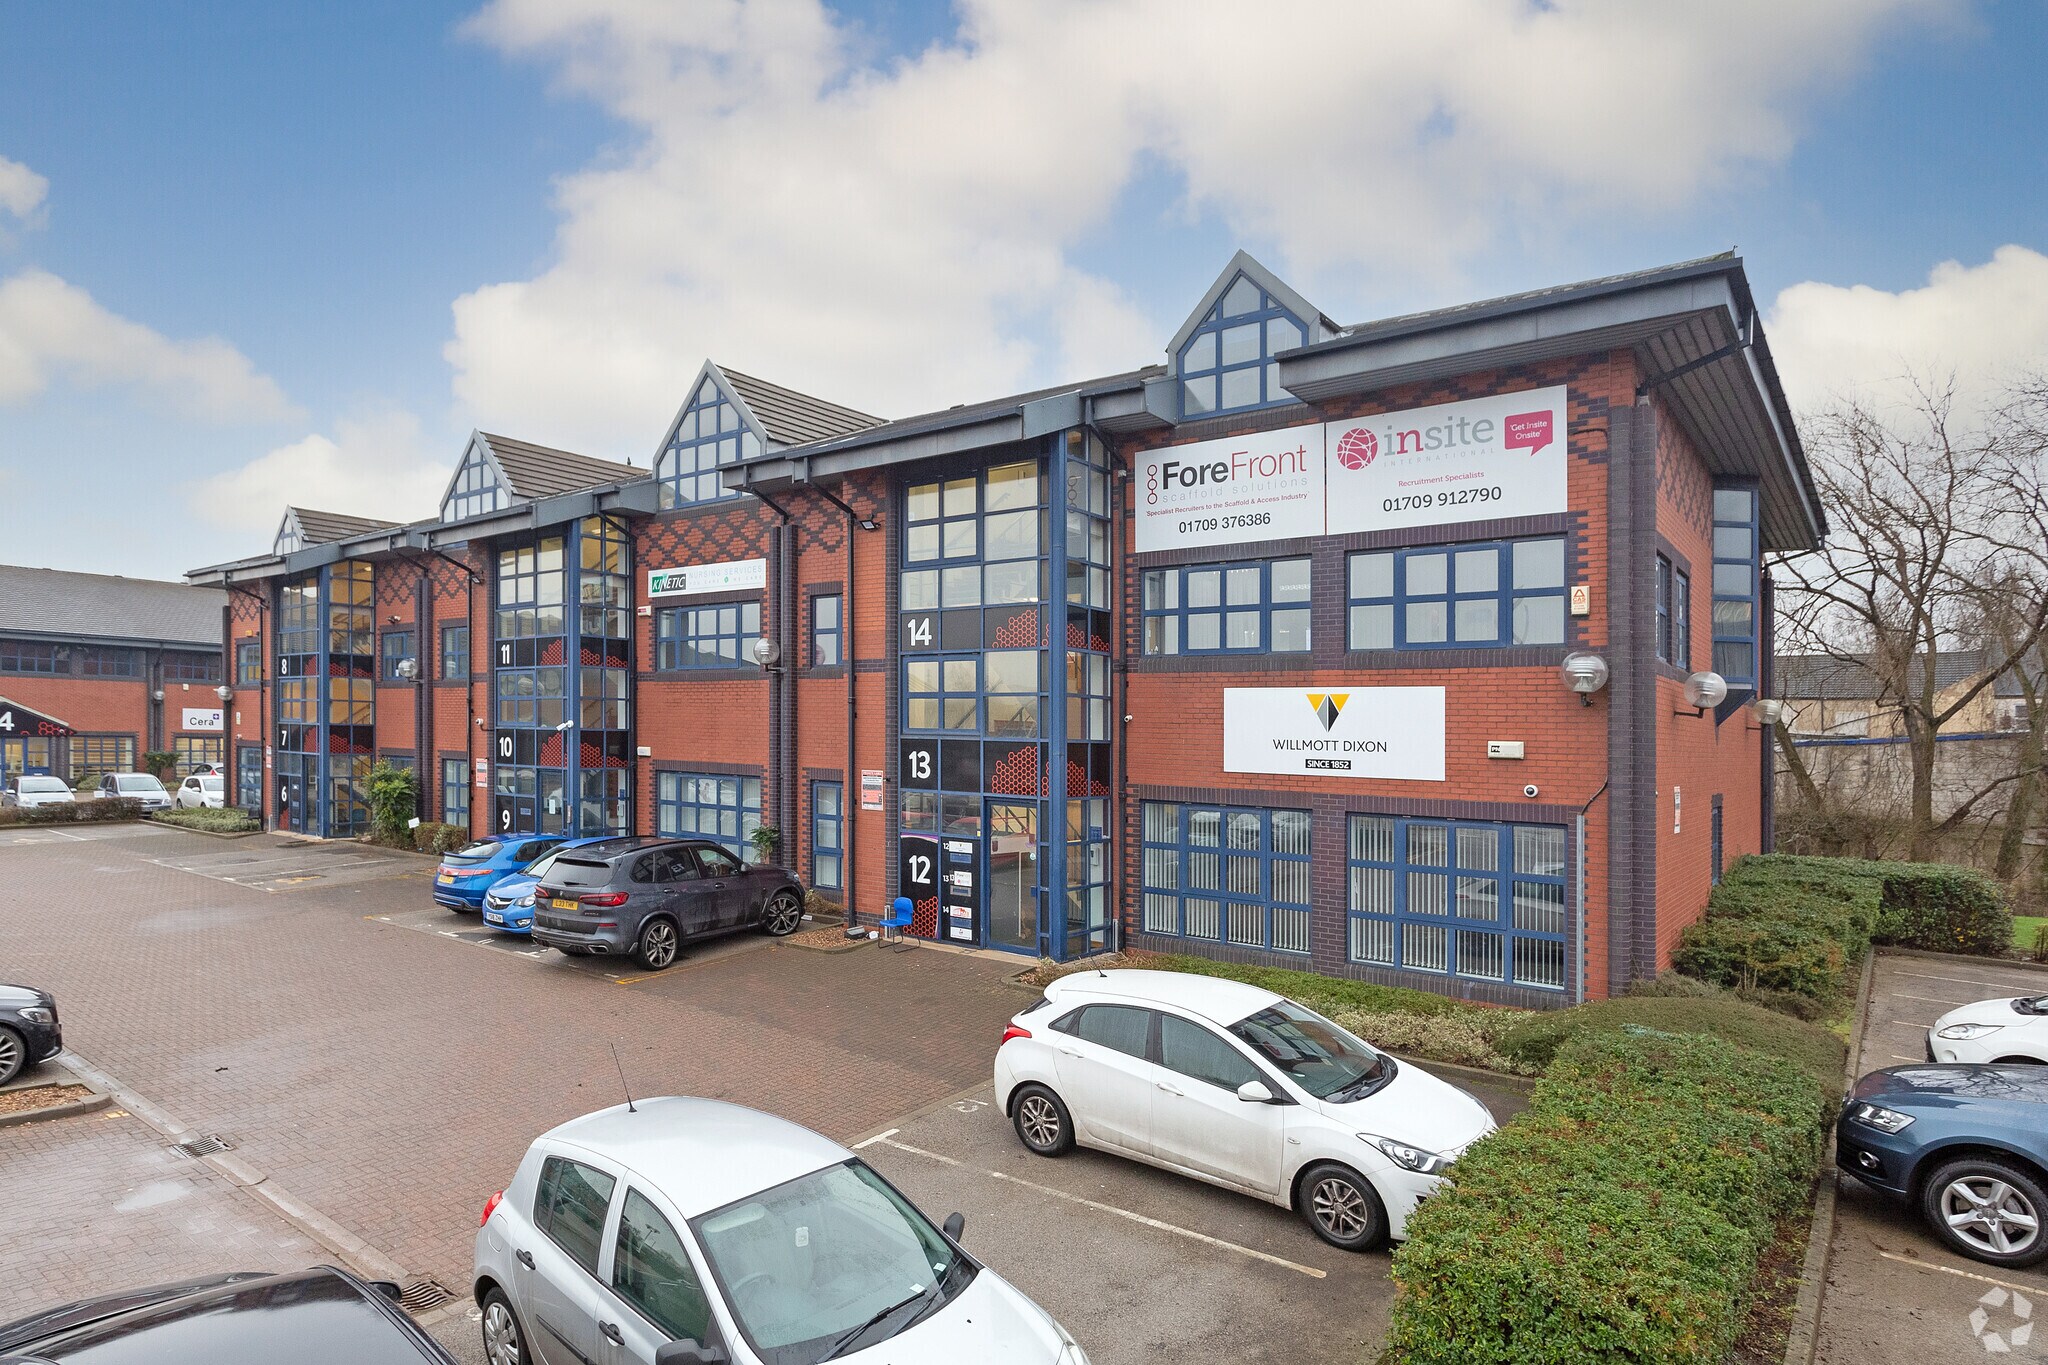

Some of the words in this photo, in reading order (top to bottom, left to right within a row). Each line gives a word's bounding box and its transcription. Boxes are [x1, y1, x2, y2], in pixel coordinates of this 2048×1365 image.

[1526, 420, 1548, 430] Insite
[1384, 415, 1495, 457] insite
[1162, 444, 1307, 490] ForeFront
[1384, 447, 1495, 468] INTERNATIONAL
[1398, 475, 1443, 487] Recruitment
[1444, 470, 1485, 482] Specialists
[1162, 486, 1223, 503] scaffold
[1232, 477, 1308, 495] solutions
[1383, 494, 1433, 512] 01709
[1438, 486, 1502, 506] 912790
[1174, 504, 1205, 514] Recruiters
[1224, 499, 1250, 508] Scaffold
[1256, 496, 1280, 504] Access
[1178, 518, 1218, 534] 01709
[1221, 512, 1271, 529] 376386
[688, 569, 721, 579] NURSING
[724, 565, 762, 576] SERVICES
[652, 575, 686, 590] KINETIC
[907, 617, 932, 646] 14
[501, 644, 510, 664] 11
[281, 658, 287, 674] 8
[0, 711, 15, 731] 4
[189, 717, 214, 727] Cera
[281, 730, 287, 746] 7
[499, 737, 513, 757] 10
[1272, 739, 1339, 752] WILLMOTT
[1343, 740, 1387, 753] DIXON
[908, 750, 931, 779] 13
[1307, 760, 1330, 768] SINCE
[1331, 760, 1349, 769] 1852
[281, 786, 287, 801] 6
[502, 809, 511, 830] 9
[908, 855, 931, 884] 12
